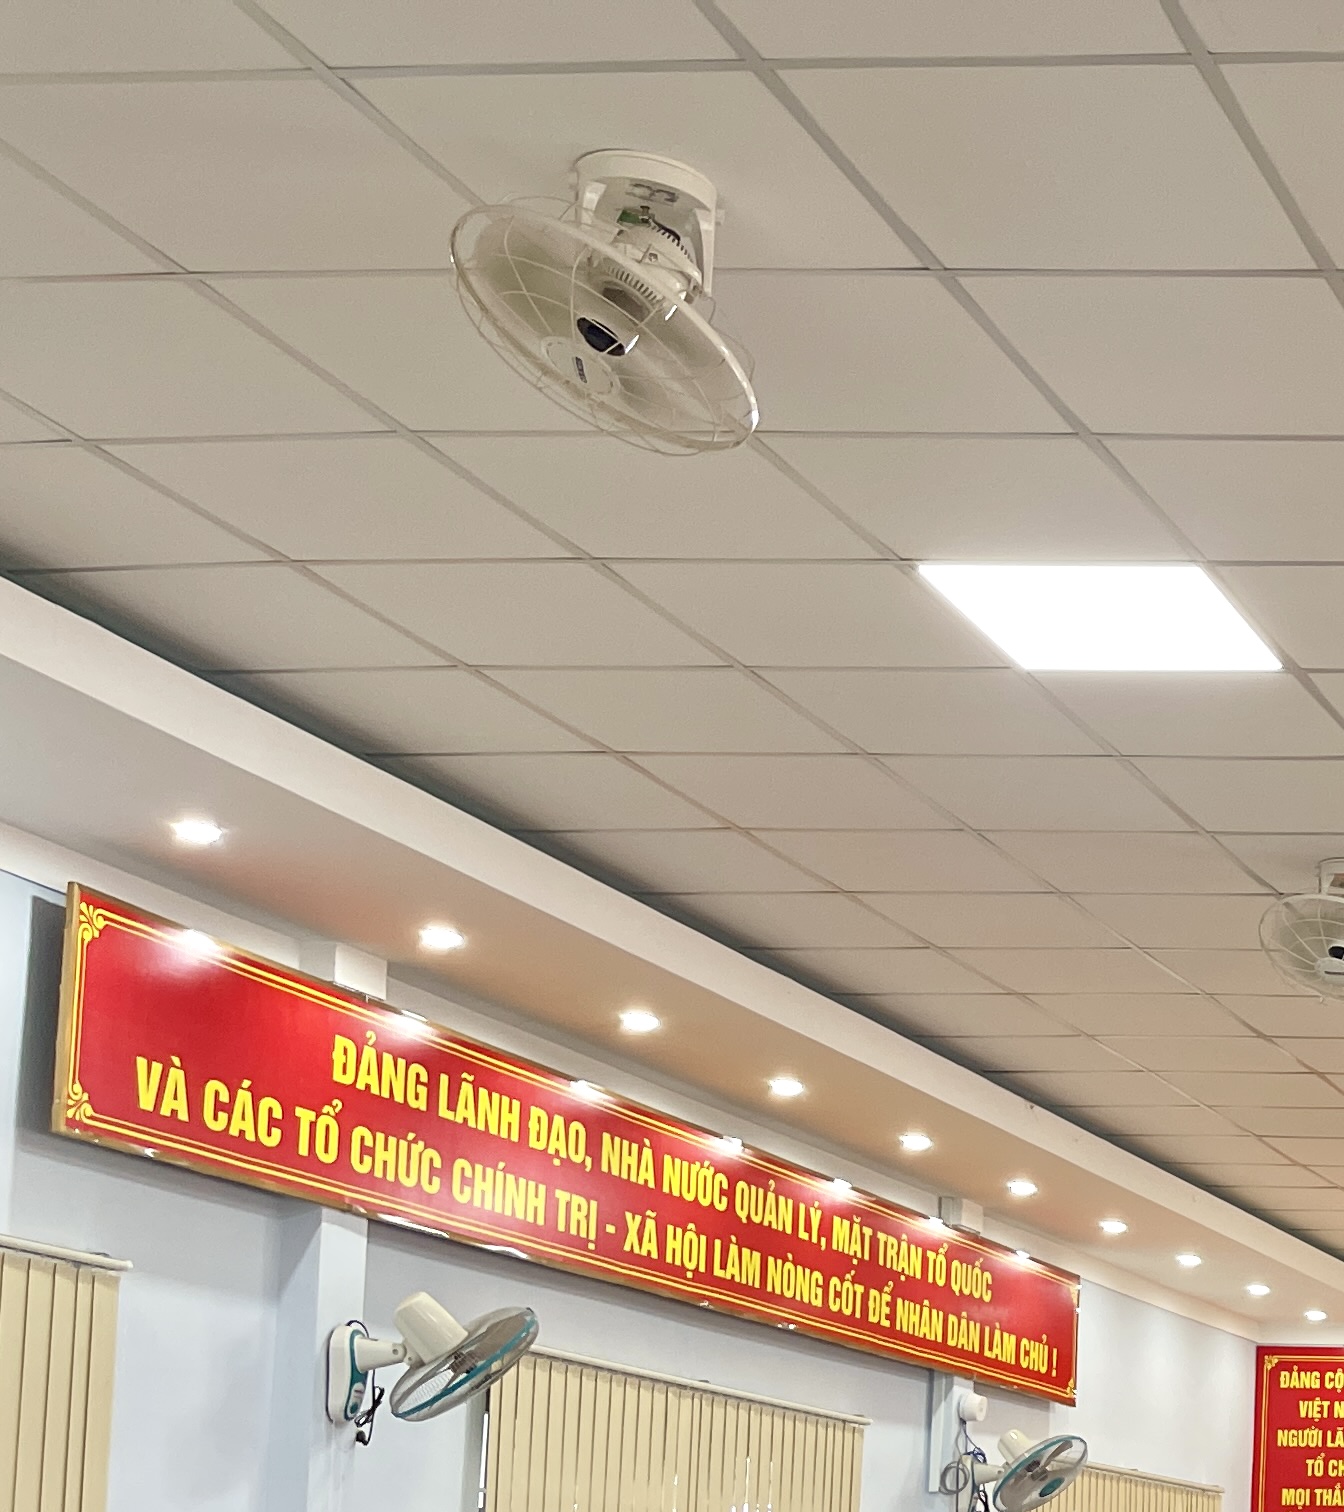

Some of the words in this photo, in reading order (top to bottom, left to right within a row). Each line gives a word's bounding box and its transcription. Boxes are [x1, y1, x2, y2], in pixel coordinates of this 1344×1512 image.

[332, 1030, 428, 1111] ĐẢNG
[438, 1072, 520, 1142] LÃNH
[528, 1105, 592, 1172] ĐẠO,
[600, 1132, 655, 1188] NHÀ
[662, 1154, 728, 1211] NƯỚC
[735, 1179, 793, 1234] QUẢN
[798, 1199, 826, 1250] LÝ,
[831, 1215, 872, 1264] MẶT
[876, 1231, 922, 1281] TRẬN
[926, 1241, 948, 1286] TỔ
[950, 1258, 992, 1302] QUỐC
[136, 1055, 188, 1121] VÀ
[203, 1079, 282, 1147] CÁC
[295, 1099, 342, 1163] TỔ
[350, 1126, 442, 1195] CHỨC
[451, 1158, 546, 1226] CHÍNH
[554, 1188, 598, 1250] TRỊ
[623, 1209, 658, 1259] XÃ
[665, 1222, 706, 1278] HỘI
[713, 1235, 760, 1288] LÀM
[766, 1252, 823, 1307] NÒNG
[828, 1270, 864, 1318] CỐT
[868, 1280, 893, 1327] ĐỂ
[895, 1297, 943, 1342] NHÂN
[947, 1311, 980, 1353] DÂN
[983, 1322, 1016, 1364] LÀM
[1019, 1334, 1048, 1373] CHỦ
[1279, 1365, 1321, 1389] ĐẢNG
[1299, 1397, 1330, 1421] VIỆT
[1277, 1425, 1322, 1447] NGƯỜI
[1305, 1452, 1324, 1476] TỔ
[1281, 1488, 1310, 1509] MỌI
